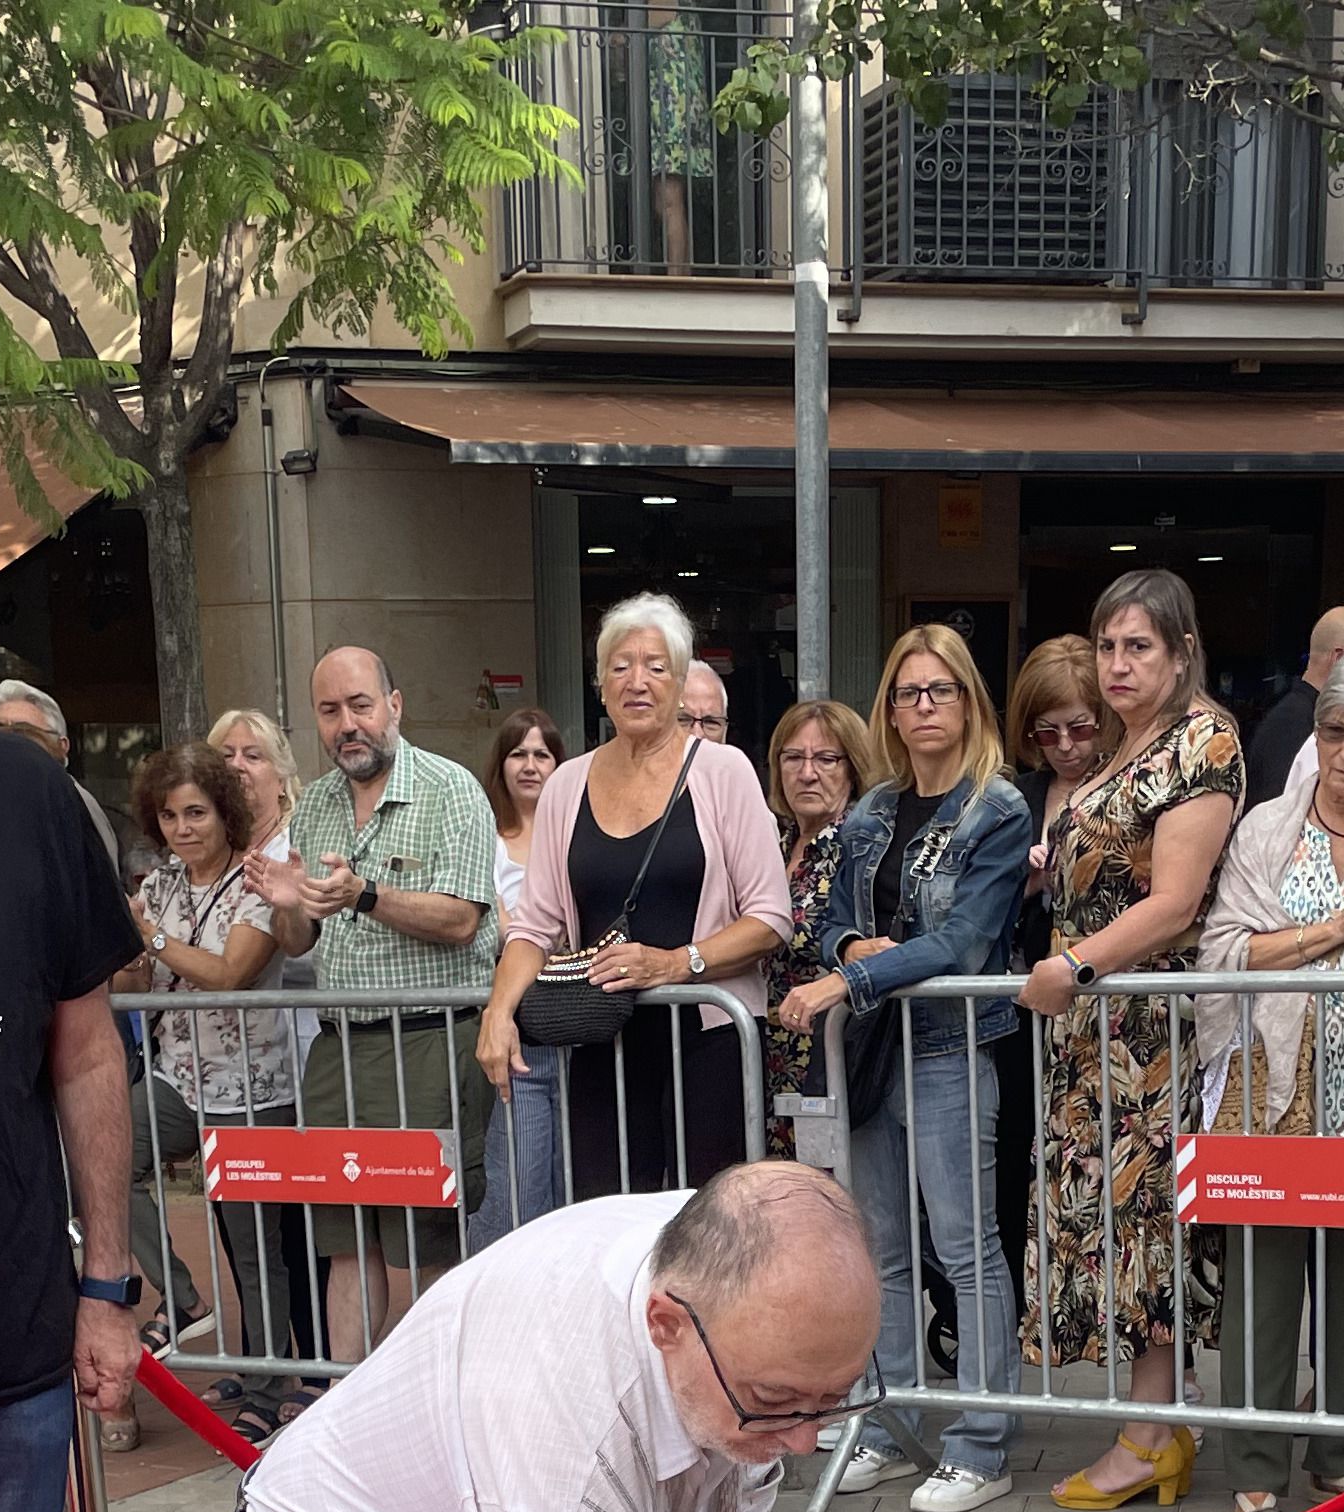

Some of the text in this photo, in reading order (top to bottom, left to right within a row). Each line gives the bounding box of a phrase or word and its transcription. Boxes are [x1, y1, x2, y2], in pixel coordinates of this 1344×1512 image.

[225, 1159, 266, 1169] DISCULPEU
[365, 1165, 406, 1177] Ajuntament
[407, 1166, 416, 1176] de
[1206, 1174, 1263, 1185] DISCULPEU
[1206, 1187, 1286, 1200] LES MOLÈSTIES!
